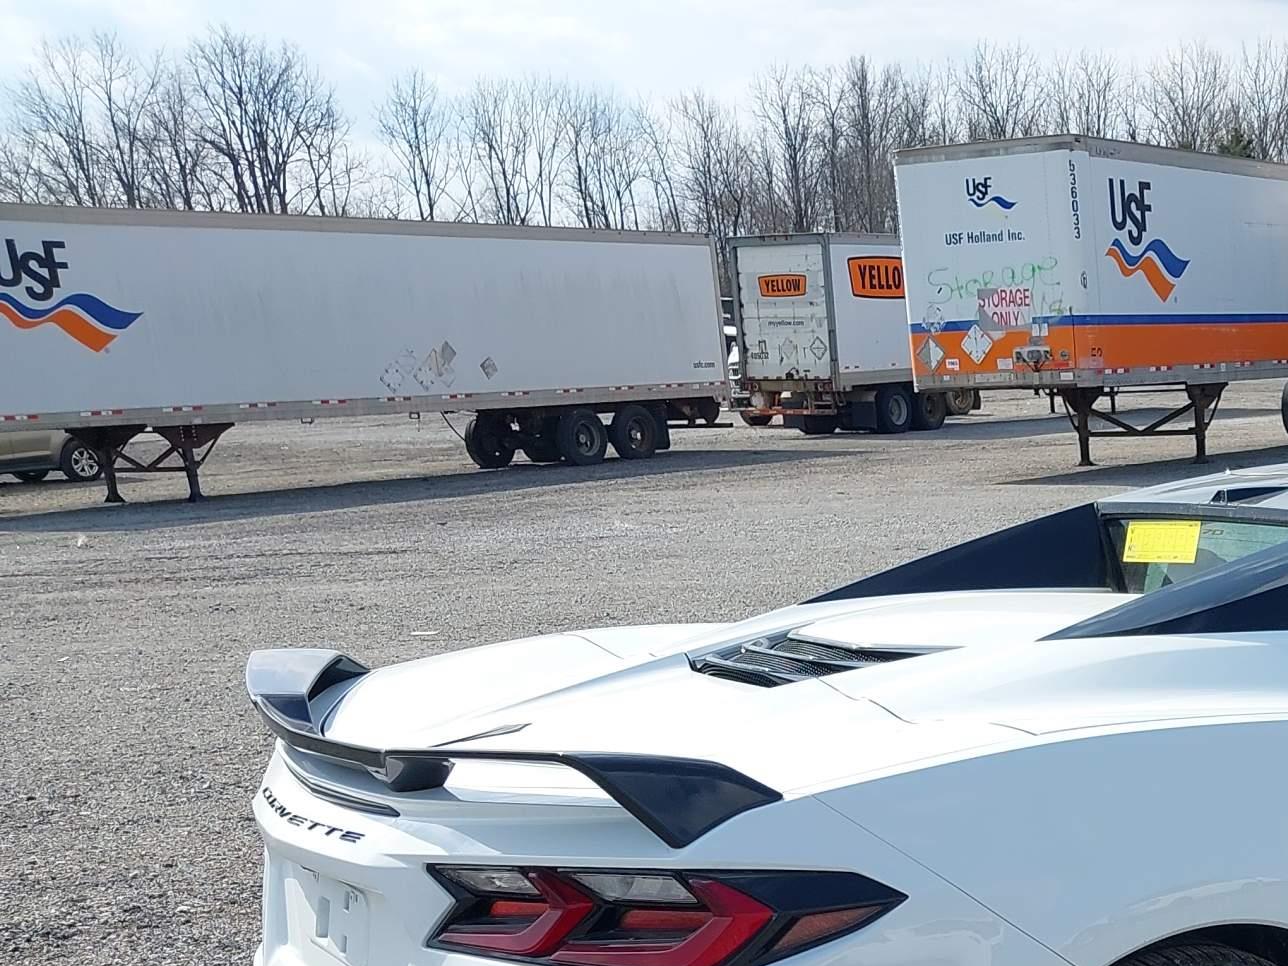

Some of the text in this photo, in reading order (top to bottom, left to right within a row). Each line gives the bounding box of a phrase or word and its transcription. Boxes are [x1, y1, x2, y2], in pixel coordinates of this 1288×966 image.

[965, 176, 992, 201] USF
[1108, 177, 1152, 247] USF
[945, 228, 1025, 246] USF Holland Inc.
[764, 277, 801, 293] YELLOW
[857, 263, 905, 290] YELLO
[978, 288, 1031, 308] STORAGE
